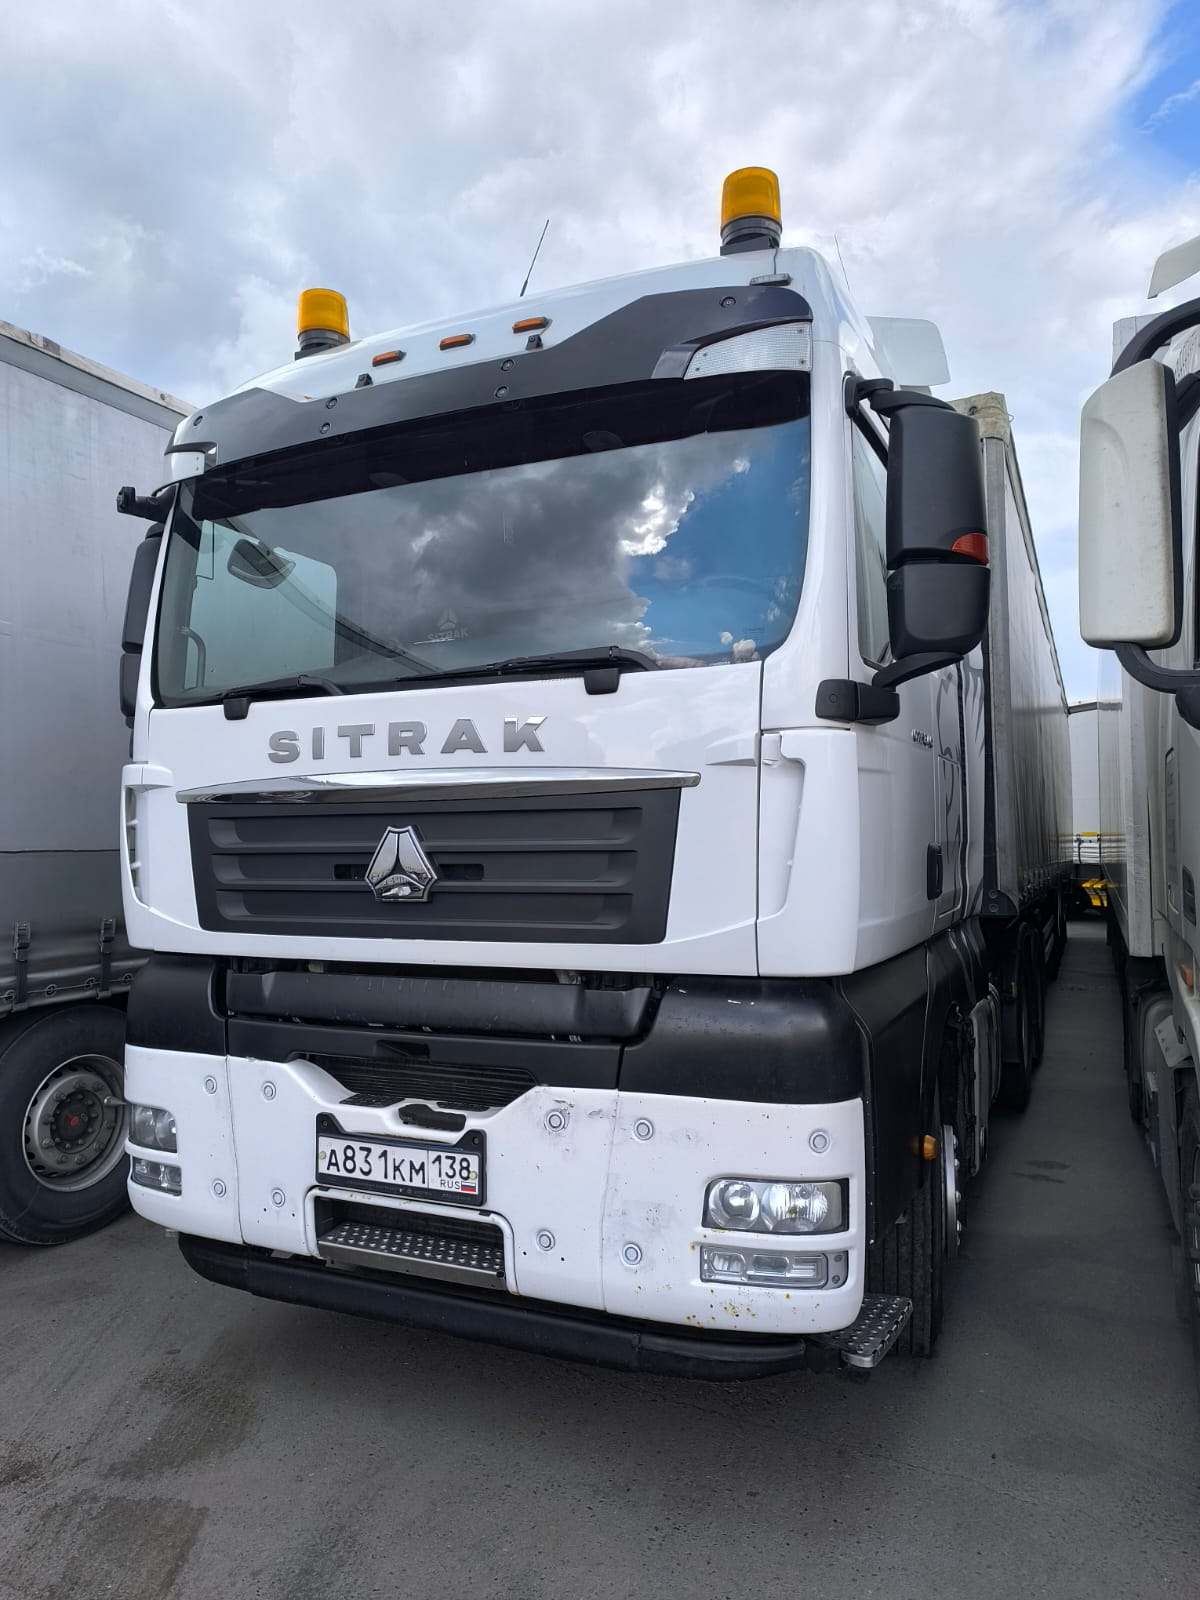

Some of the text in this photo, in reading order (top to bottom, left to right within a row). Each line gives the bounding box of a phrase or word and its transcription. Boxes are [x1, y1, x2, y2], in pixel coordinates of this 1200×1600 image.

[267, 715, 548, 763] SITRAK
[431, 1154, 471, 1181] 138
[440, 1179, 461, 1190] RUS
